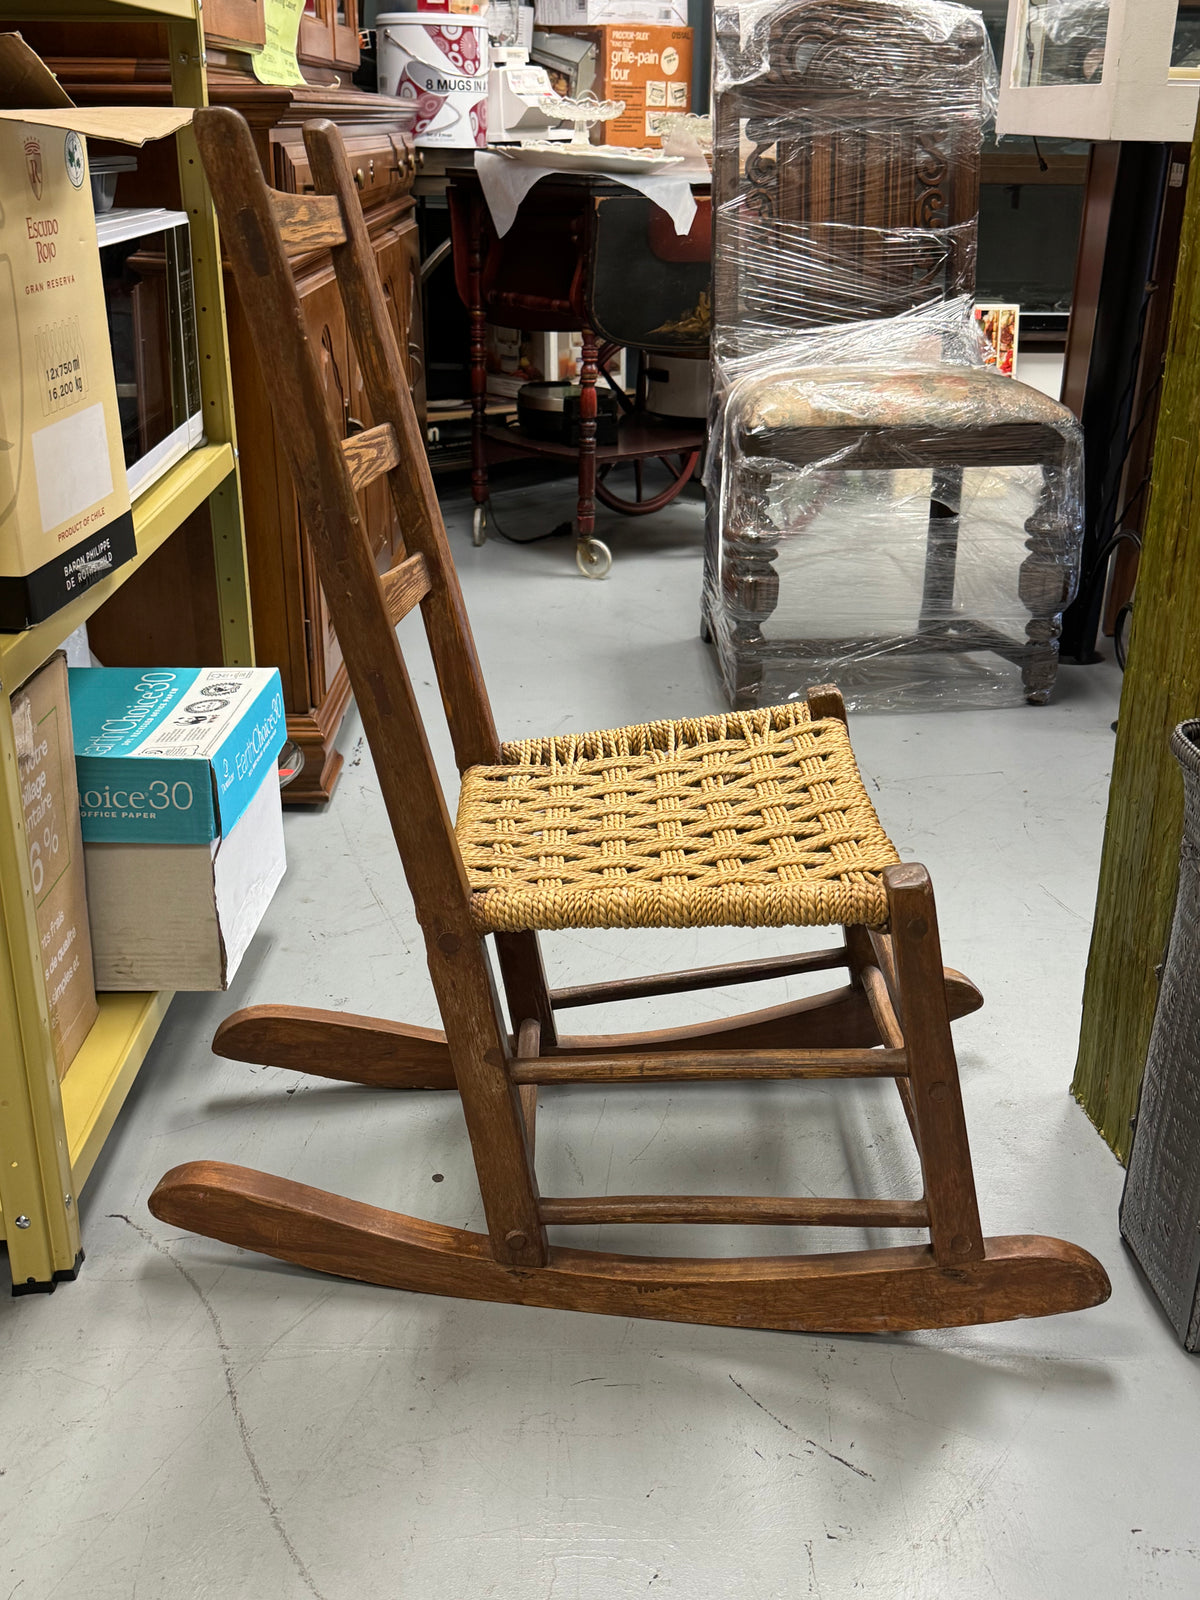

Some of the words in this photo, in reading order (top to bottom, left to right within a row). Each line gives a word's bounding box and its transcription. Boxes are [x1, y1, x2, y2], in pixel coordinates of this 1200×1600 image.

[611, 48, 659, 67] grille-pain
[610, 65, 630, 80] four
[426, 79, 433, 90] 8
[437, 80, 472, 91] MUGS
[474, 81, 482, 91] IN
[25, 282, 44, 295] GRAN
[46, 275, 75, 290] RESERVA
[46, 361, 73, 381] 12x750
[74, 375, 82, 392] kg
[57, 521, 82, 542] PRODUCT
[82, 516, 90, 526] OF
[90, 507, 105, 522] CHILE
[63, 555, 86, 577] BARON
[85, 537, 111, 562] PHILIPPE
[65, 577, 76, 591] DE
[80, 811, 117, 819] OFFICE
[121, 811, 157, 819] PAPER
